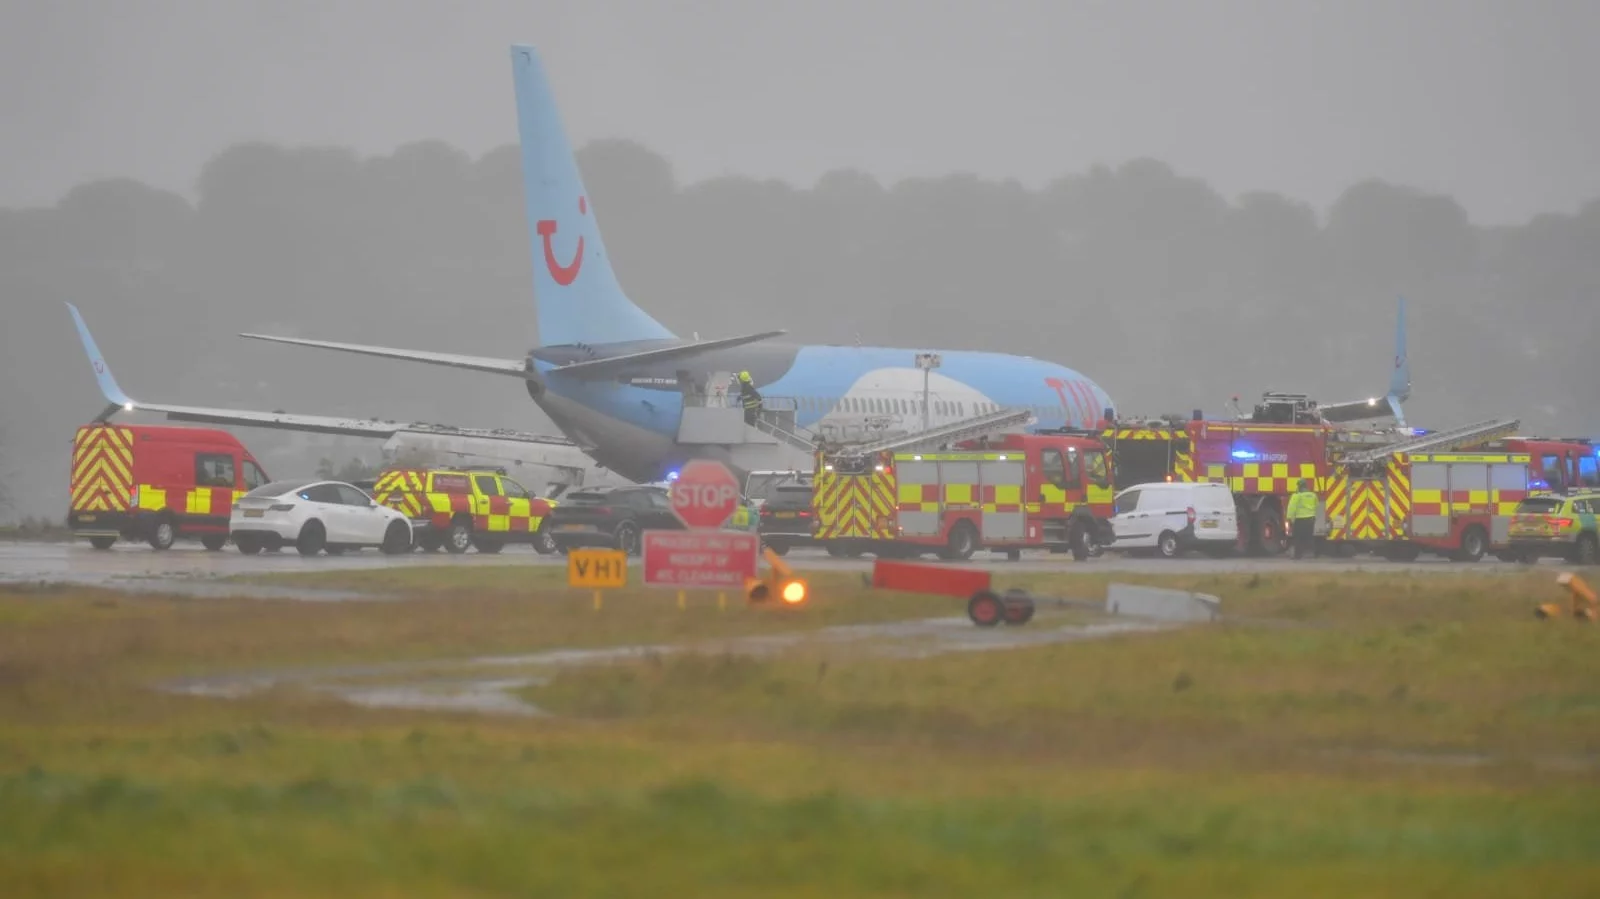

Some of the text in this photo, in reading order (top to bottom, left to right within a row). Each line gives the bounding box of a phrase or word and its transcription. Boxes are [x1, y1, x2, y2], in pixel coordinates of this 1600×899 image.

[1044, 377, 1107, 430] TUI
[675, 484, 736, 508] STOP
[575, 558, 621, 579] VH1
